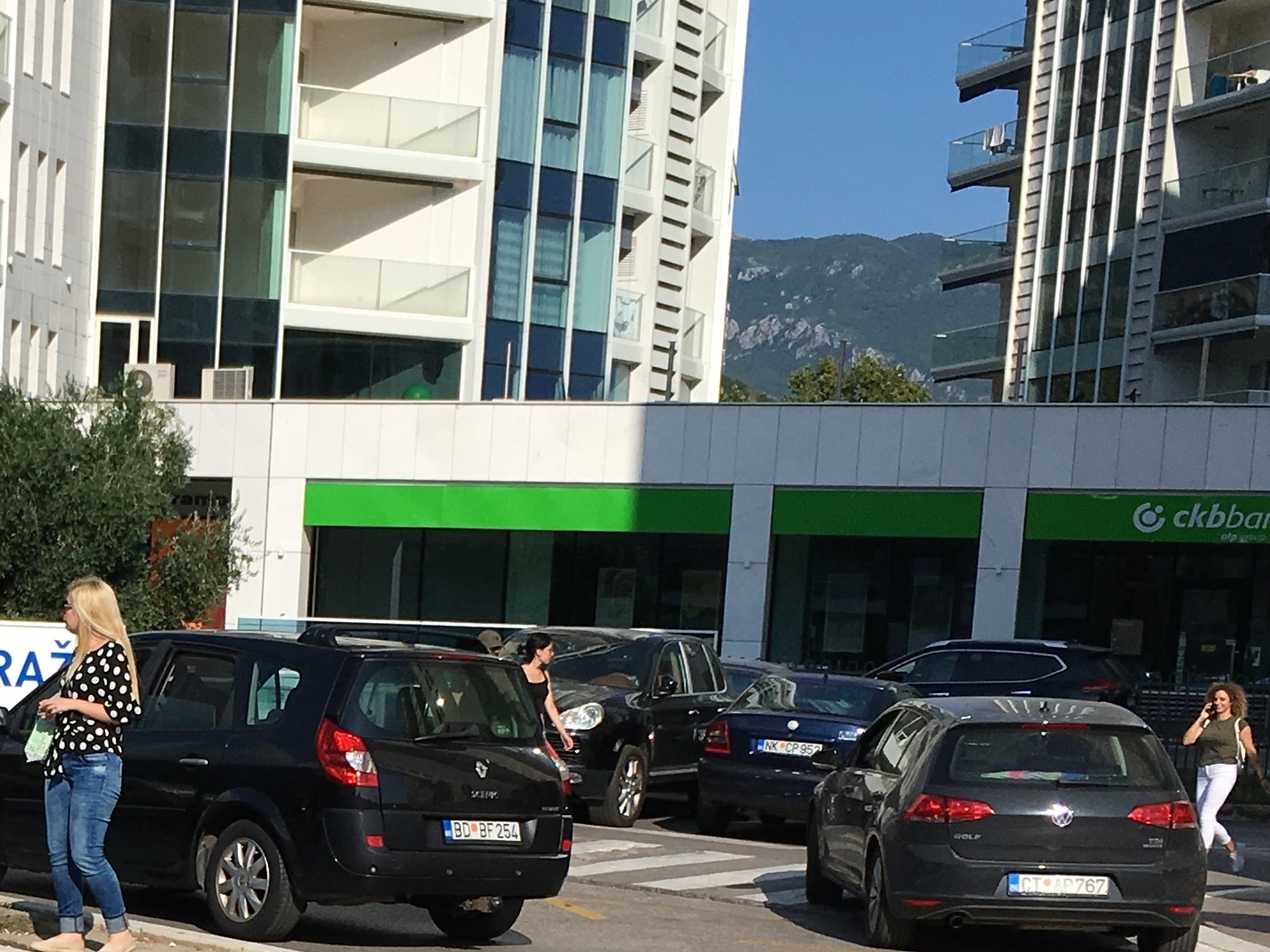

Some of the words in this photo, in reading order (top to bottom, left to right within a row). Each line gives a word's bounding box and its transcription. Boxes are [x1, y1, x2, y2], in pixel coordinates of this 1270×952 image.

[764, 741, 779, 752] NK
[453, 821, 471, 838] BD
[1021, 877, 1042, 892] CT
